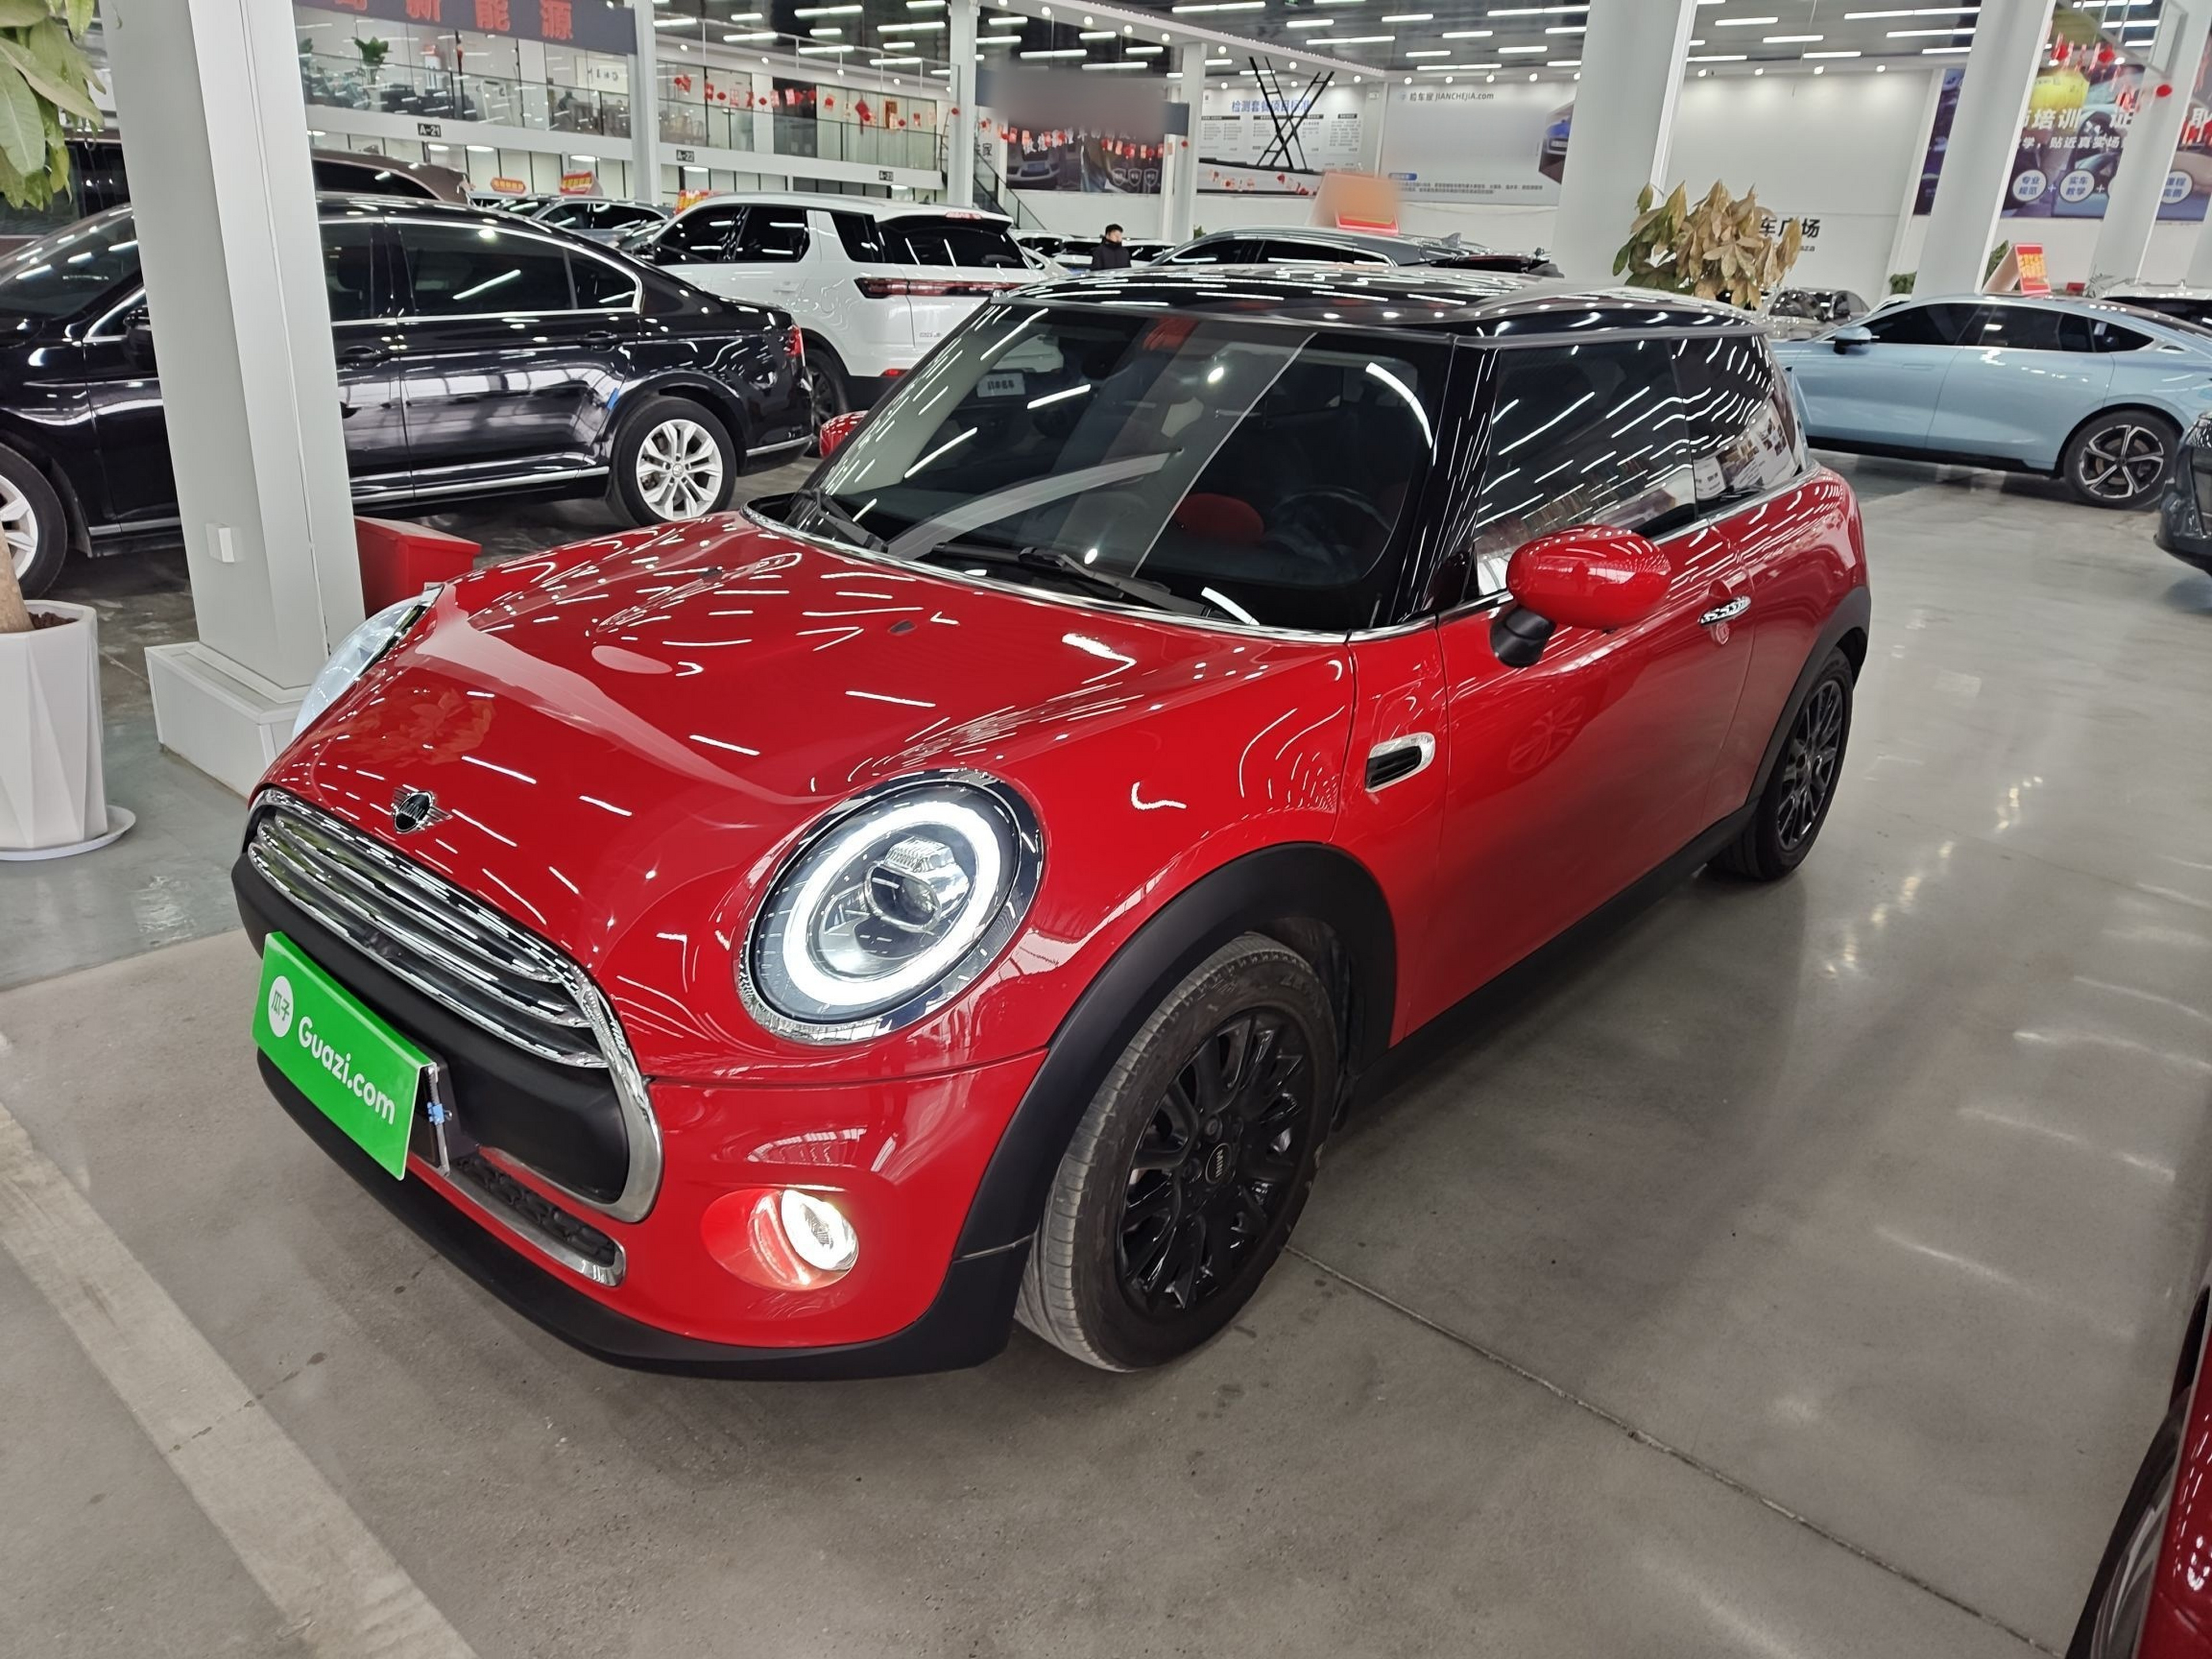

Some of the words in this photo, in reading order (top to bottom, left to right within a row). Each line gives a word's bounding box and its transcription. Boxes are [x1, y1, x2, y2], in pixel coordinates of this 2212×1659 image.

[335, 0, 573, 40] 新能源
[419, 124, 440, 136] A-21
[271, 989, 290, 1022] 瓜子
[298, 1016, 396, 1125] Guazi.com
